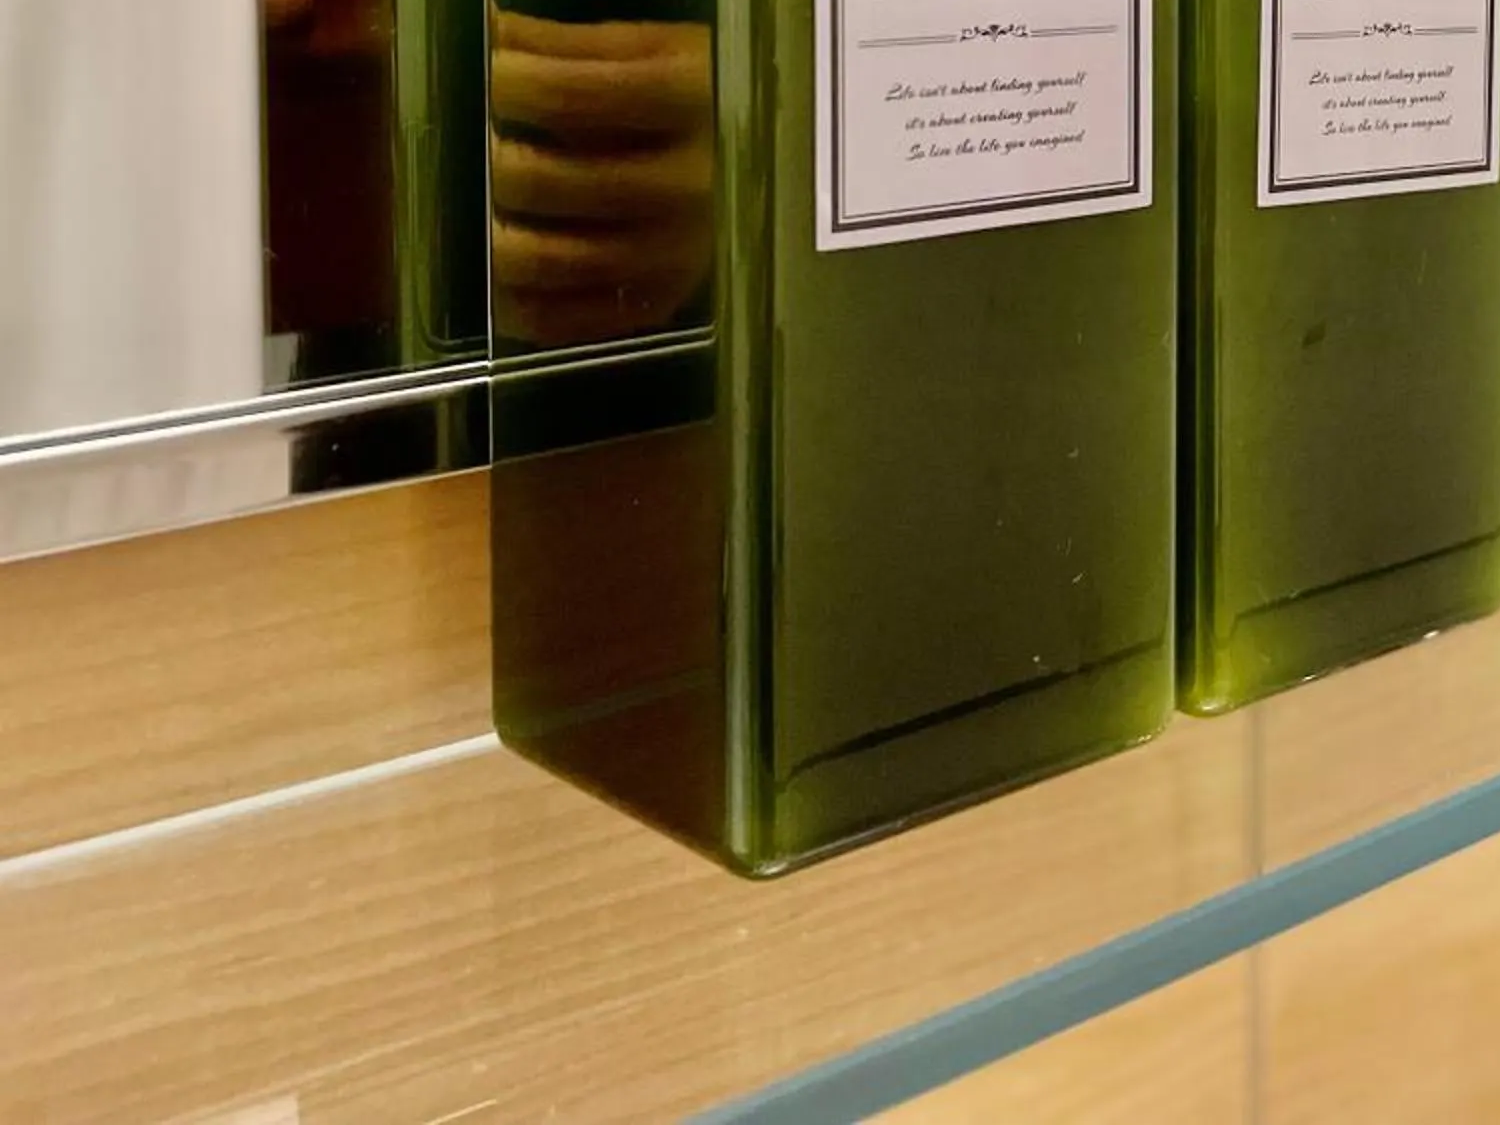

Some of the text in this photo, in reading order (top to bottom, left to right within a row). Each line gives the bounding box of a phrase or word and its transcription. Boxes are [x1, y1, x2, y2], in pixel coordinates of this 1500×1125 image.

[884, 82, 914, 101] Life
[950, 80, 988, 96] about
[990, 78, 1033, 95] finding
[1035, 71, 1087, 94] yourself
[929, 112, 966, 128] about
[969, 108, 1024, 125] creating
[1025, 101, 1078, 123] yourself
[905, 143, 925, 161] So
[955, 138, 975, 156] the
[1003, 140, 1026, 156] you
